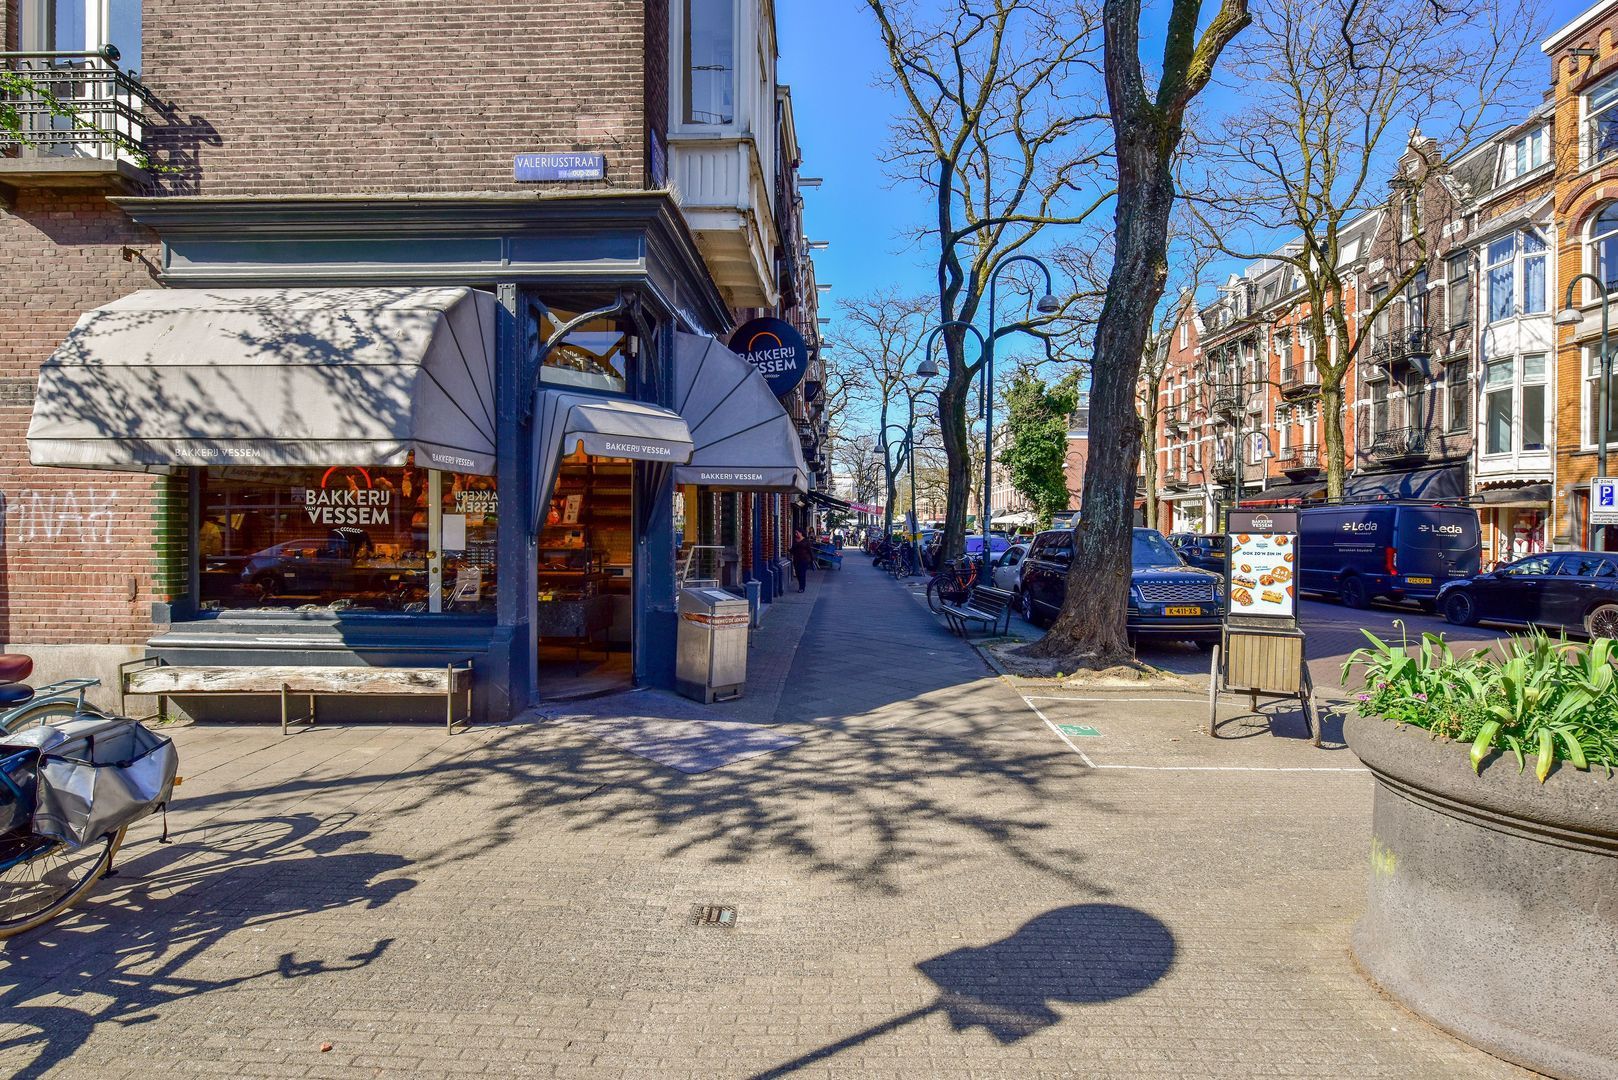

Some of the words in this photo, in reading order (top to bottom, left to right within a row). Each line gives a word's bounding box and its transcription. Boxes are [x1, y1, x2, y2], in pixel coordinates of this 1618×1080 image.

[517, 156, 600, 168] VALERIUSSTRAAT
[174, 448, 219, 457] BAKKERIJ
[221, 448, 261, 457] VESSEM
[605, 442, 640, 453] BAKKERIJ
[641, 445, 671, 456] VESSEM
[700, 472, 733, 480] BAKKERIJ
[733, 473, 763, 481] VESSEM
[305, 489, 390, 505] BAKKERIJ
[1602, 486, 1611, 498] P
[308, 507, 390, 525] VESSEM
[1352, 521, 1378, 531] Leda
[1431, 524, 1463, 534] Leda
[1169, 607, 1198, 615] K-411-XS
